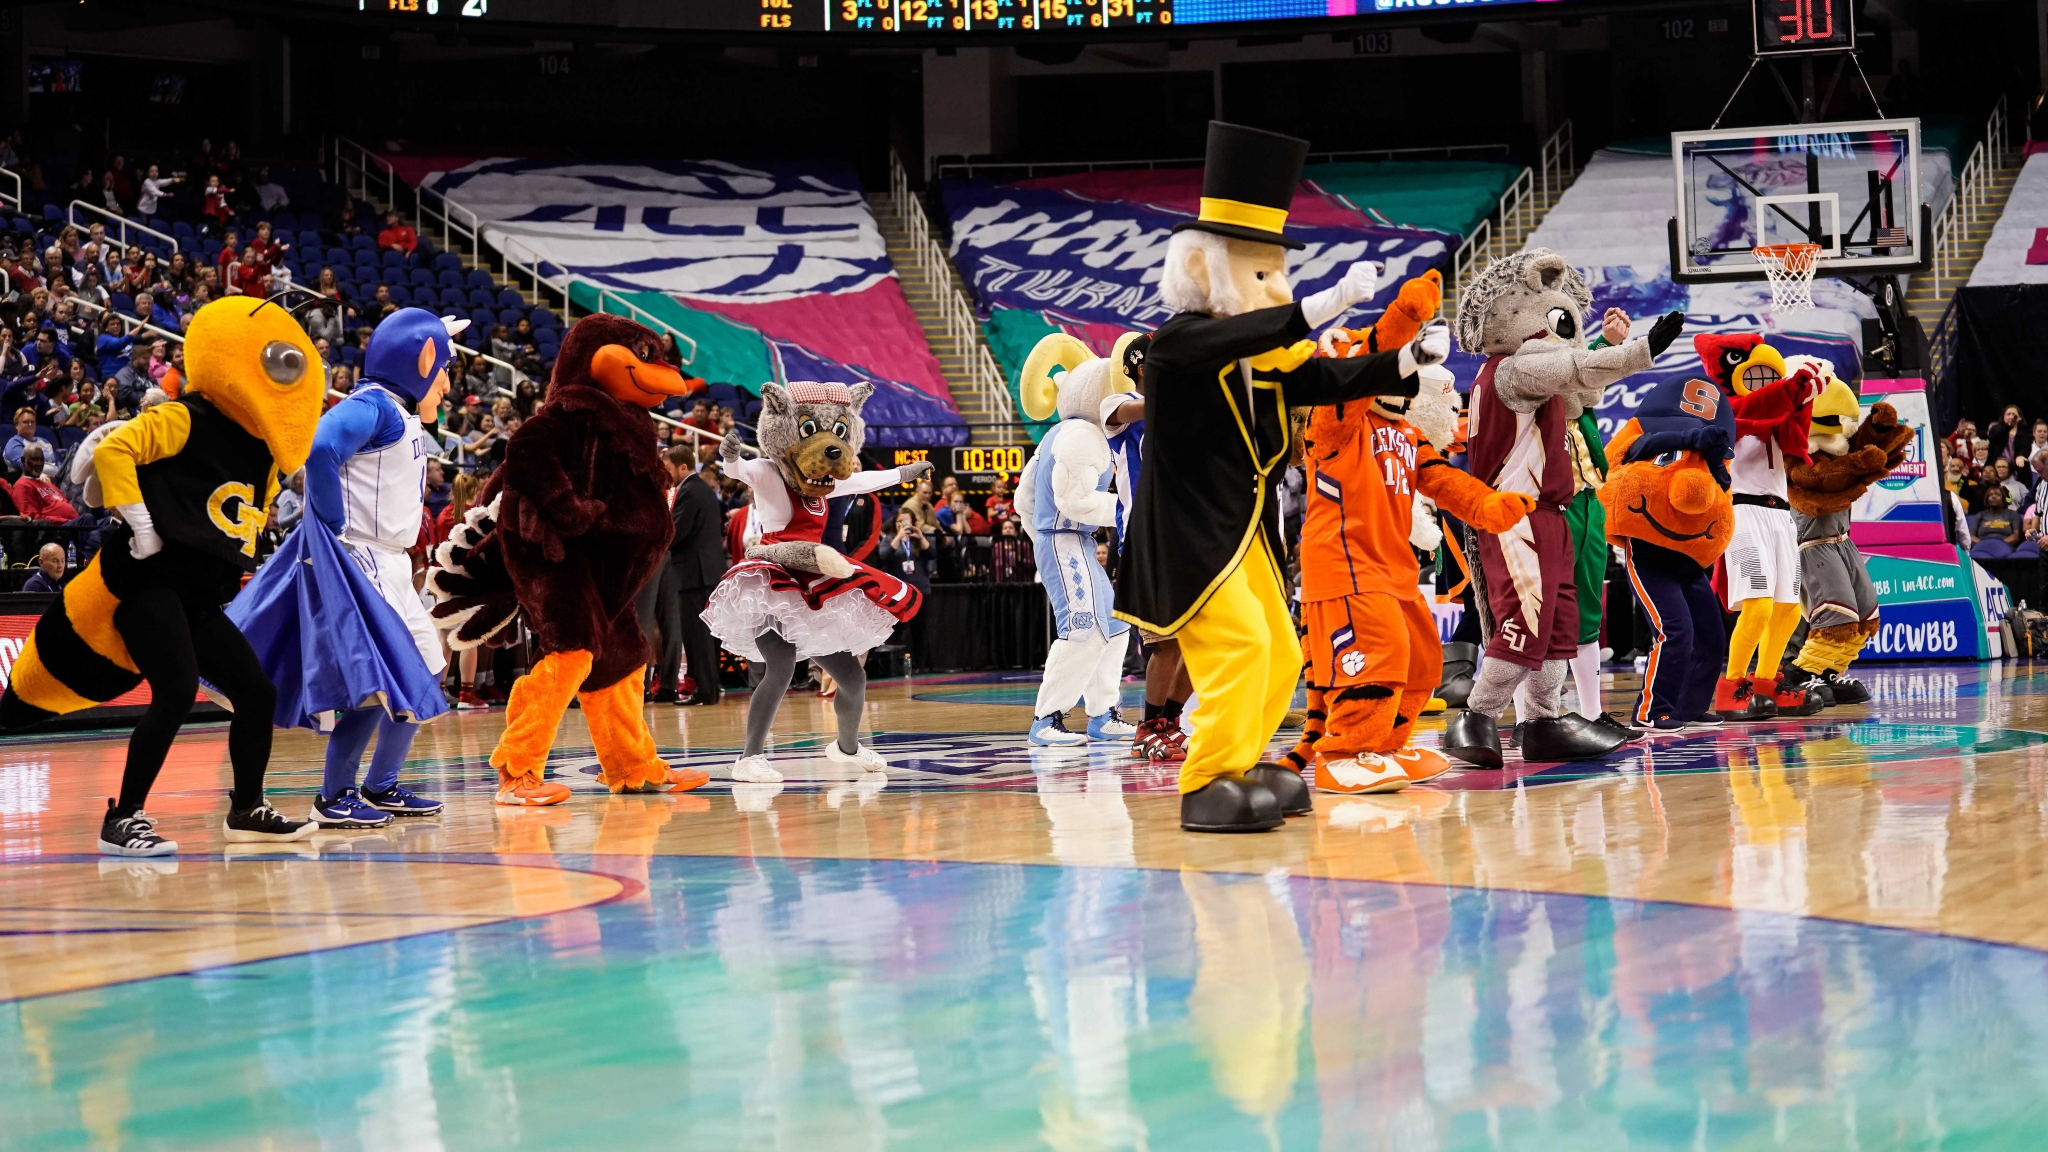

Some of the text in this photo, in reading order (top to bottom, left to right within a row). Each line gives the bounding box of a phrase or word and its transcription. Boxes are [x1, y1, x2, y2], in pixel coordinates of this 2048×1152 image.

[900, 0, 928, 21] 12
[970, 0, 999, 20] 13
[1039, 0, 1068, 19] 15
[1135, 11, 1172, 25] PT 0
[760, 14, 792, 28] FLS
[857, 17, 894, 30] PT 0
[927, 17, 945, 29] PT
[998, 15, 1034, 29] PT 5
[1066, 13, 1103, 27] PT 6
[1661, 19, 1695, 39] 102
[1779, 0, 1833, 41] 30
[1356, 33, 1388, 53] 103
[537, 55, 570, 75] 104
[1679, 377, 1721, 421] S
[894, 449, 929, 465] NCST
[963, 448, 1022, 472] 10:00
